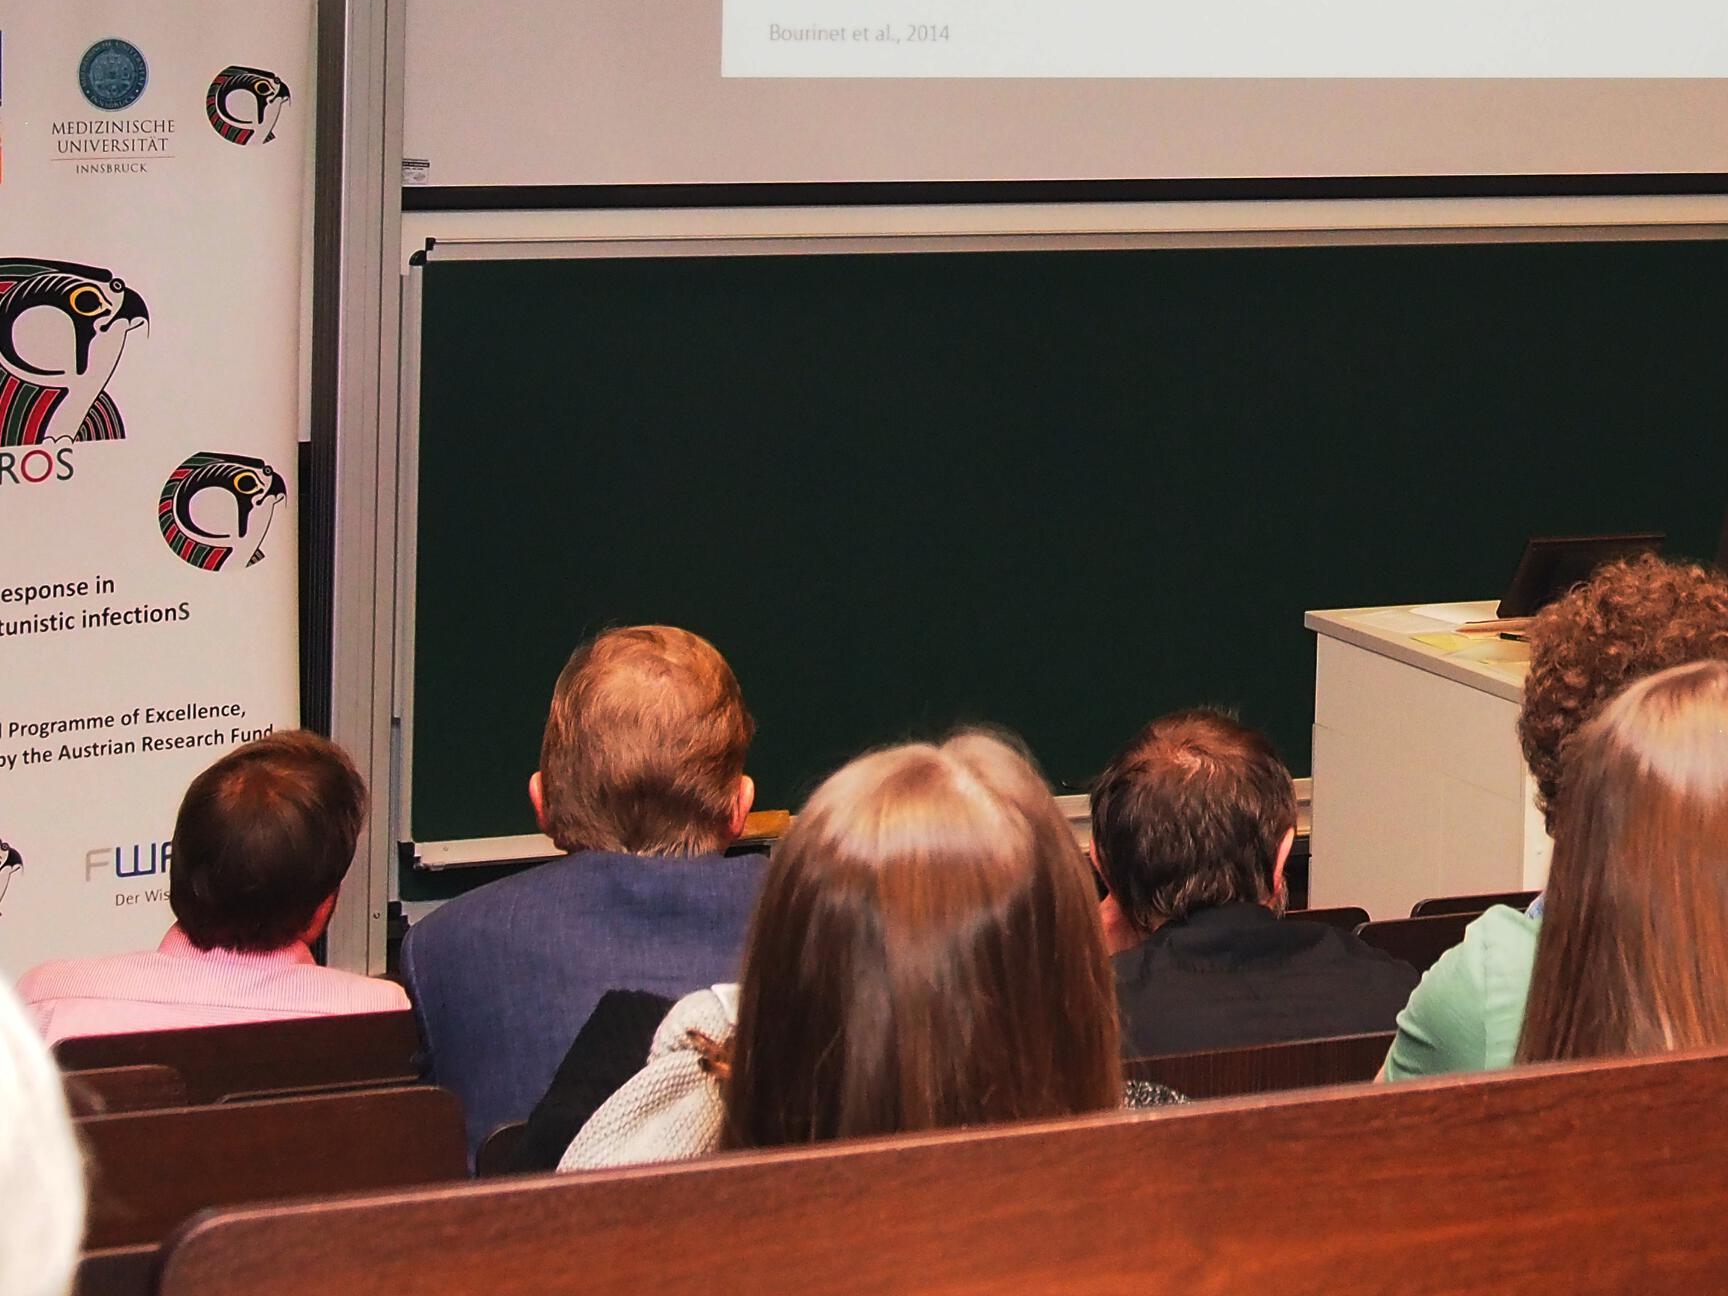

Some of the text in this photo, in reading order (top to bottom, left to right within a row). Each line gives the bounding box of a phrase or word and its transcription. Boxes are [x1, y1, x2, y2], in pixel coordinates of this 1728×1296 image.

[769, 22, 950, 44] Bourinet et al., 2014
[52, 119, 176, 136] MEDIZINISCHE
[57, 135, 169, 154] UNIVERSITÄT
[75, 162, 148, 175] INNSBRUCK
[0, 575, 115, 606] esponse in
[81, 601, 191, 630] infectionS
[8, 713, 115, 739] Programme
[120, 708, 140, 727] of
[145, 702, 247, 724] Excellence,
[22, 747, 53, 765] the
[58, 737, 136, 762] Austrian
[142, 728, 225, 753] Research
[115, 892, 140, 907] Der
